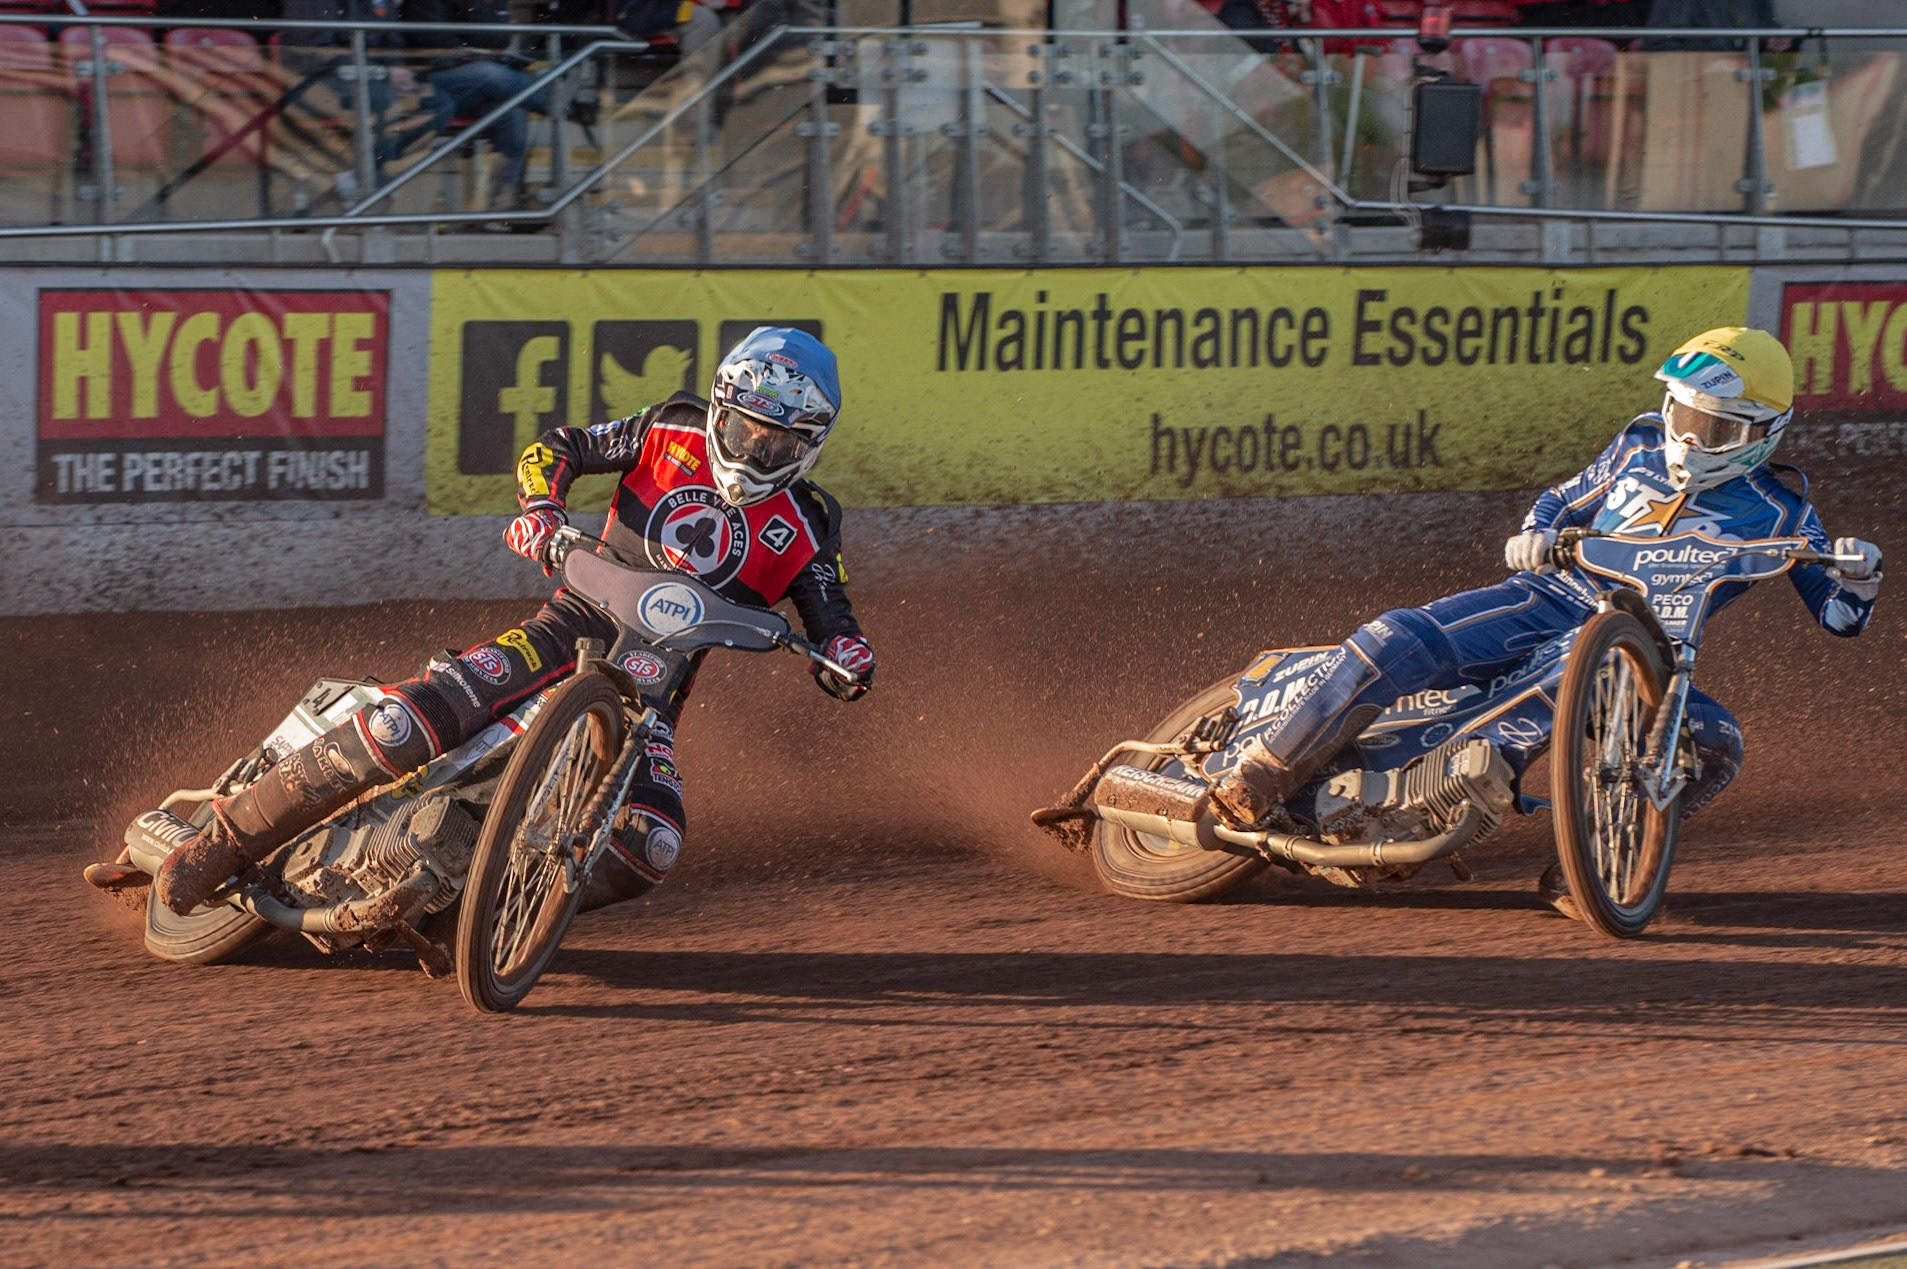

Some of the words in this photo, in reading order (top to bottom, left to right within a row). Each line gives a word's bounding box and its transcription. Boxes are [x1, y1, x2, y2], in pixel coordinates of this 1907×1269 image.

[935, 290, 1331, 373] Maintenance
[1351, 287, 1650, 366] Essentials
[52, 311, 376, 420] HYCOTE
[1701, 370, 1734, 390] ZUPIN
[1150, 410, 1442, 487] hycote.co.uk
[52, 452, 117, 494] THE
[122, 450, 262, 492] PERFECT
[267, 449, 370, 491] FINISH
[667, 491, 708, 509] BELLE
[713, 495, 737, 518] VUE
[731, 521, 744, 558] ACES
[765, 527, 790, 548] 4
[1632, 544, 1728, 571] poultec
[650, 598, 691, 621] ATPI
[1652, 594, 1694, 606] PECO
[472, 652, 498, 671] STS
[628, 659, 653, 675] STS
[446, 667, 481, 708] Silkolene
[380, 709, 401, 738] ATPI
[653, 837, 676, 858] ATPI
